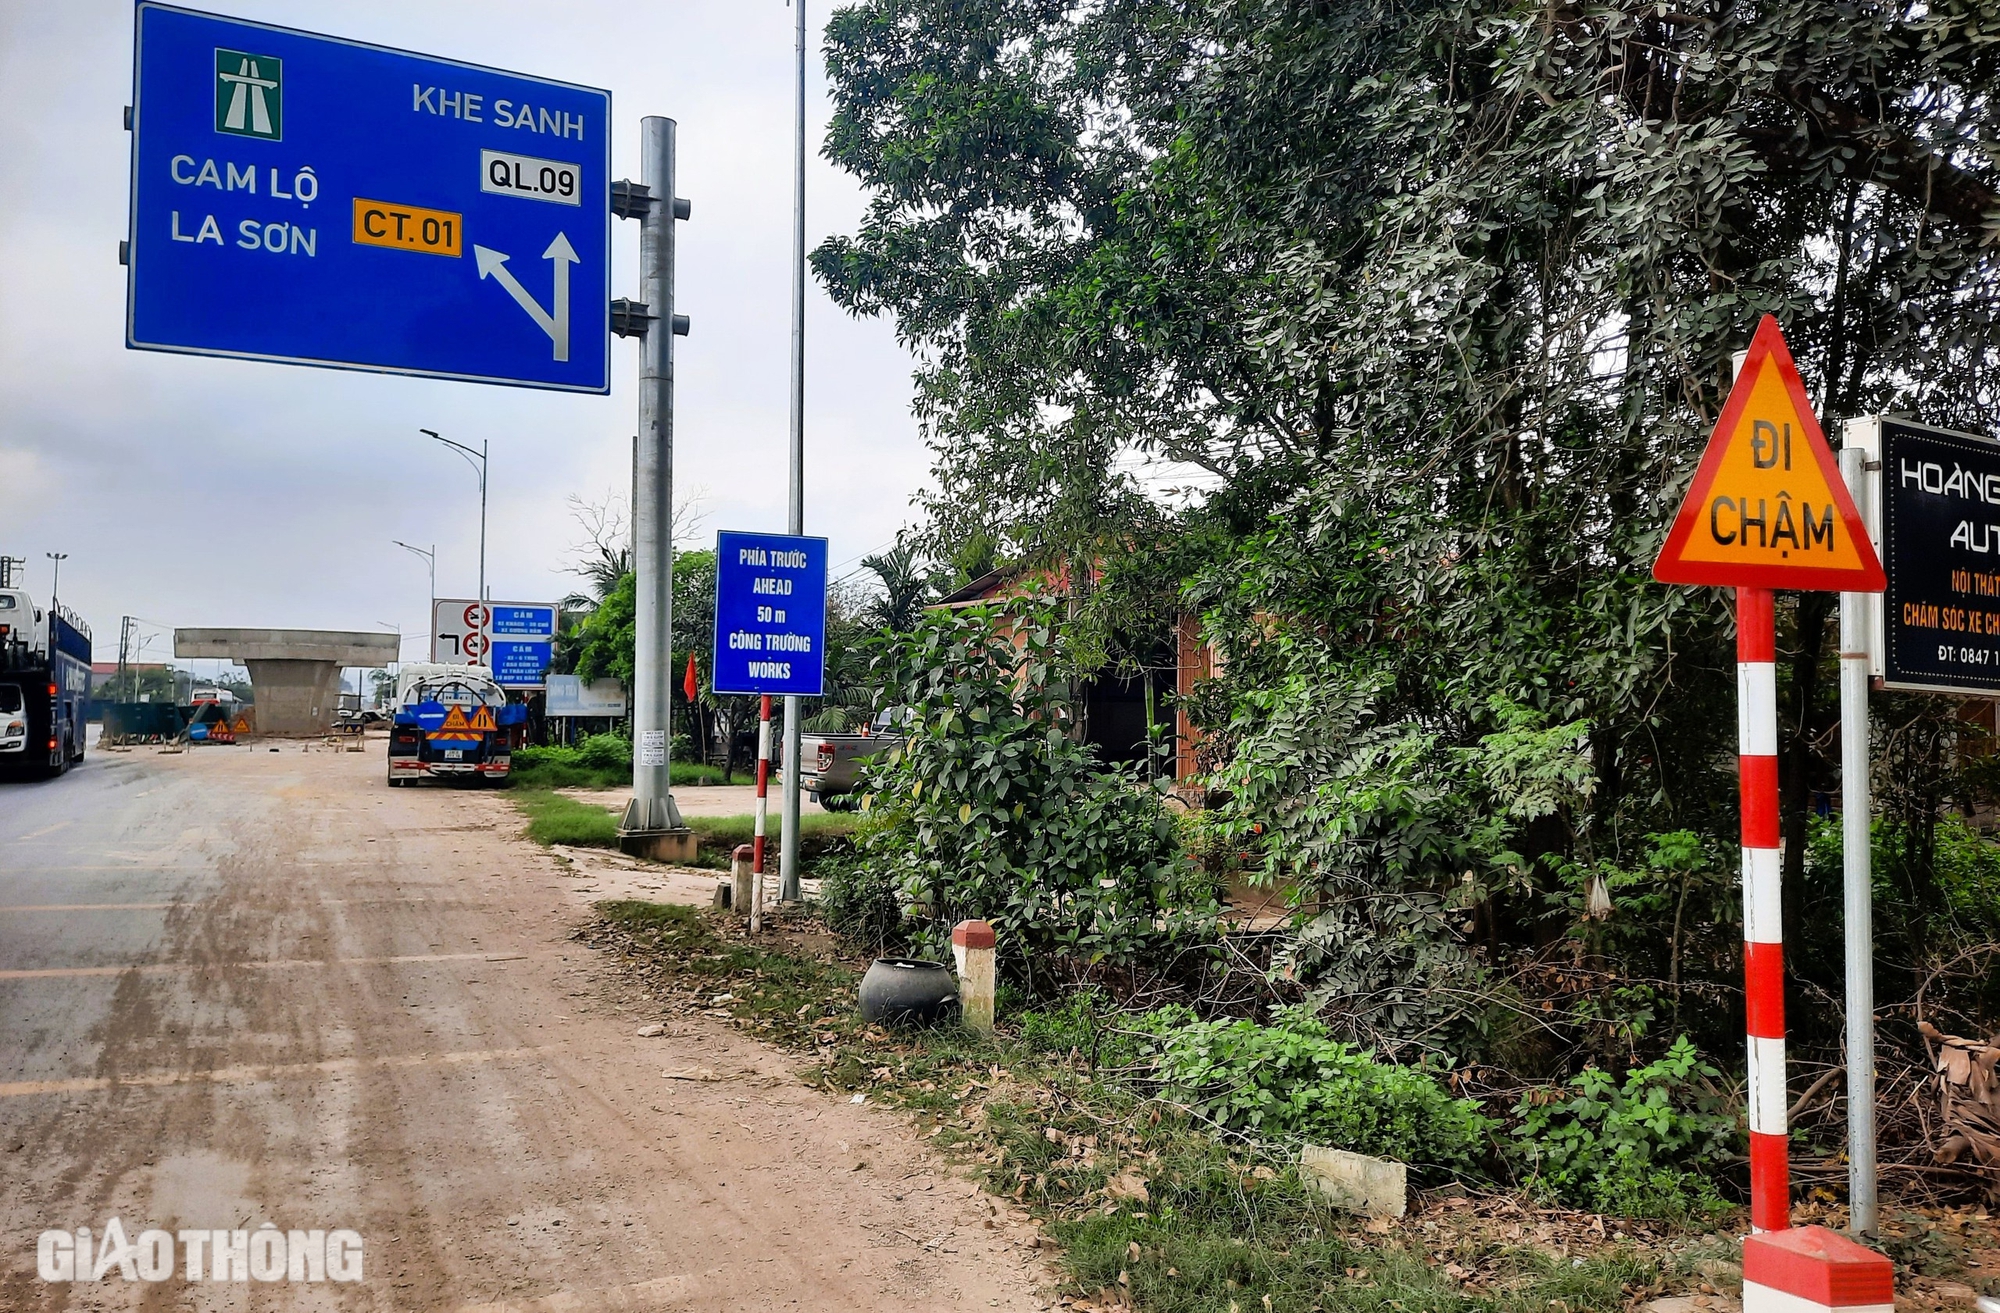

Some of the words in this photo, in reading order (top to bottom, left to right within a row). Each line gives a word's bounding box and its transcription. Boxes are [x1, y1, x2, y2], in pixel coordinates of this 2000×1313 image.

[413, 83, 482, 122] KHE
[493, 100, 583, 141] SANH
[171, 155, 256, 194] CAM
[271, 165, 318, 208] LỘ
[489, 158, 575, 198] QL.09
[172, 211, 224, 246] LA
[236, 220, 317, 257] SƠN
[363, 209, 454, 248] CT.01
[1750, 420, 1791, 471] ĐI
[1901, 457, 2000, 505] HOÀNG
[1710, 490, 1834, 558] CHẬM
[739, 547, 767, 566] PHÍA
[770, 549, 807, 569] TRƯỚC
[753, 577, 792, 596] AHEAD
[1951, 568, 1971, 598] NỘI
[1974, 568, 2000, 597] THẤT
[757, 606, 772, 623] 50
[775, 610, 786, 624] m
[1942, 604, 1965, 632] SÓC
[1968, 610, 1982, 634] XE
[729, 630, 762, 651] CÔNG
[765, 632, 811, 653] TRƯỜNG
[1938, 645, 1956, 662] ĐT:
[1960, 648, 1990, 665] 0847
[748, 661, 791, 680] WORKS
